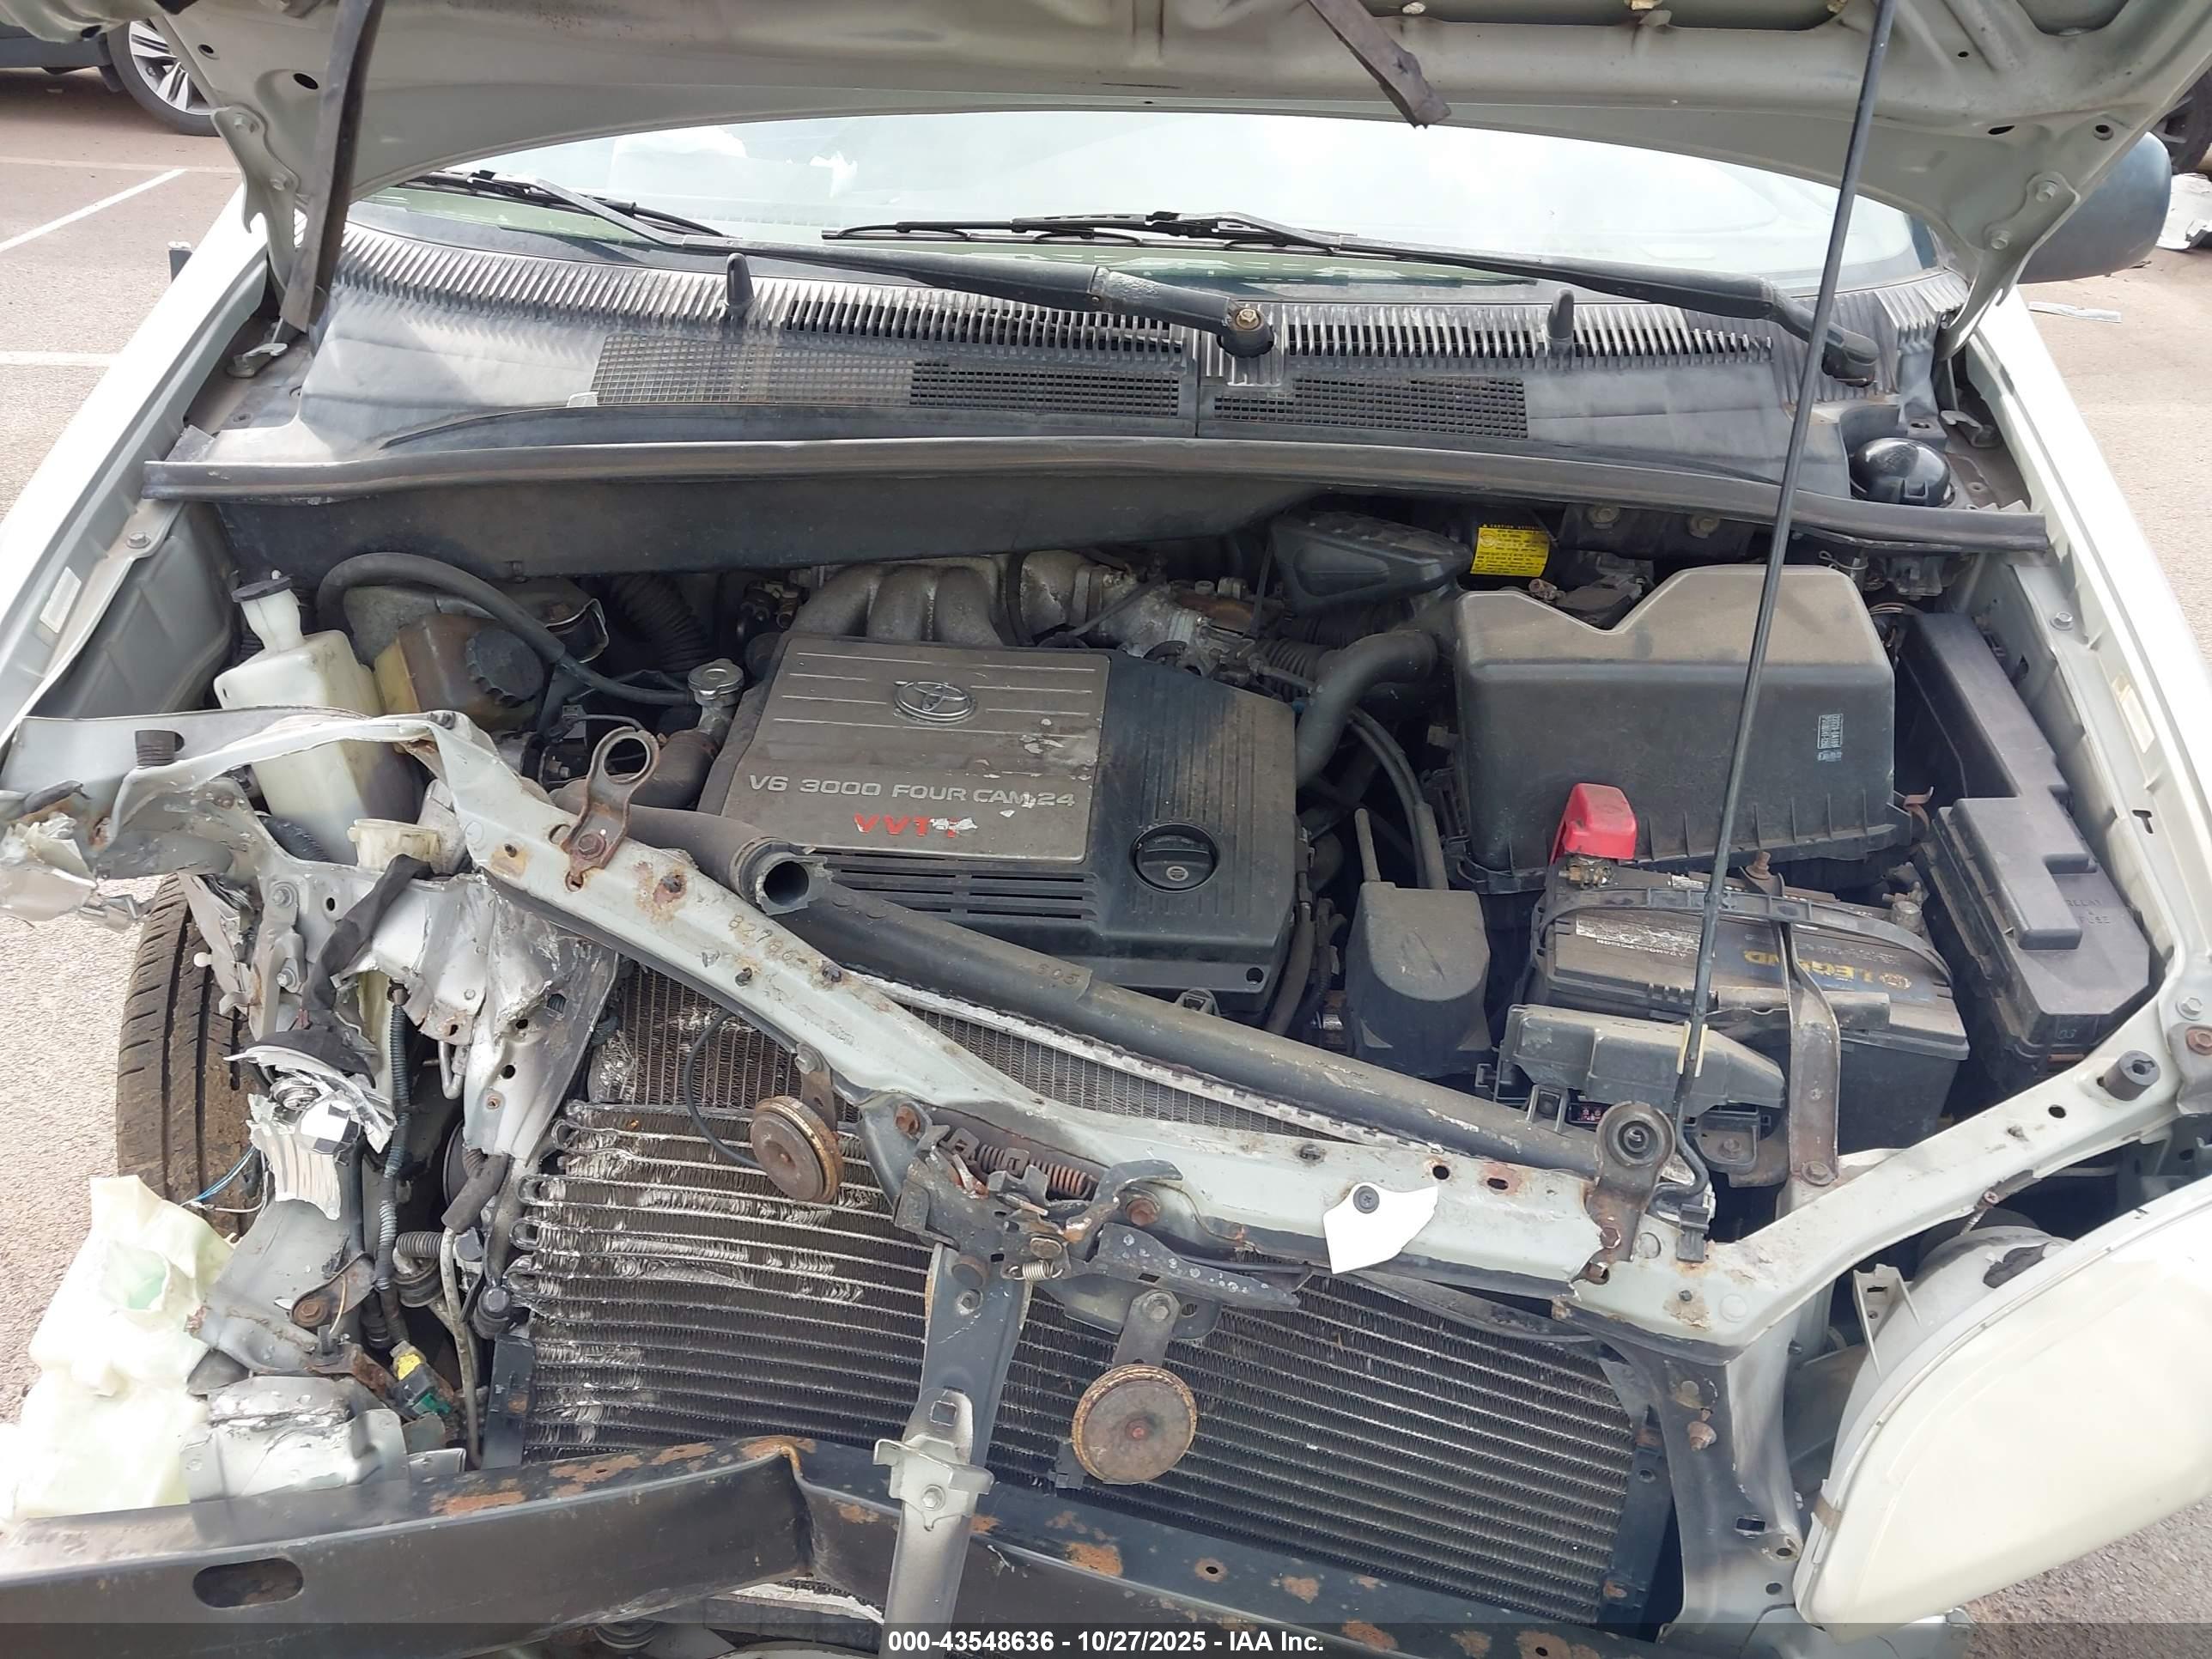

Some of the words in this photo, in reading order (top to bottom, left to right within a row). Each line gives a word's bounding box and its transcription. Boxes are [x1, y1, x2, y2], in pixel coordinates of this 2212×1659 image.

[749, 775, 789, 791] V6
[799, 779, 882, 796] 3000
[891, 784, 967, 801] FOUR
[973, 788, 1030, 805] CAM
[1036, 792, 1075, 806] 24
